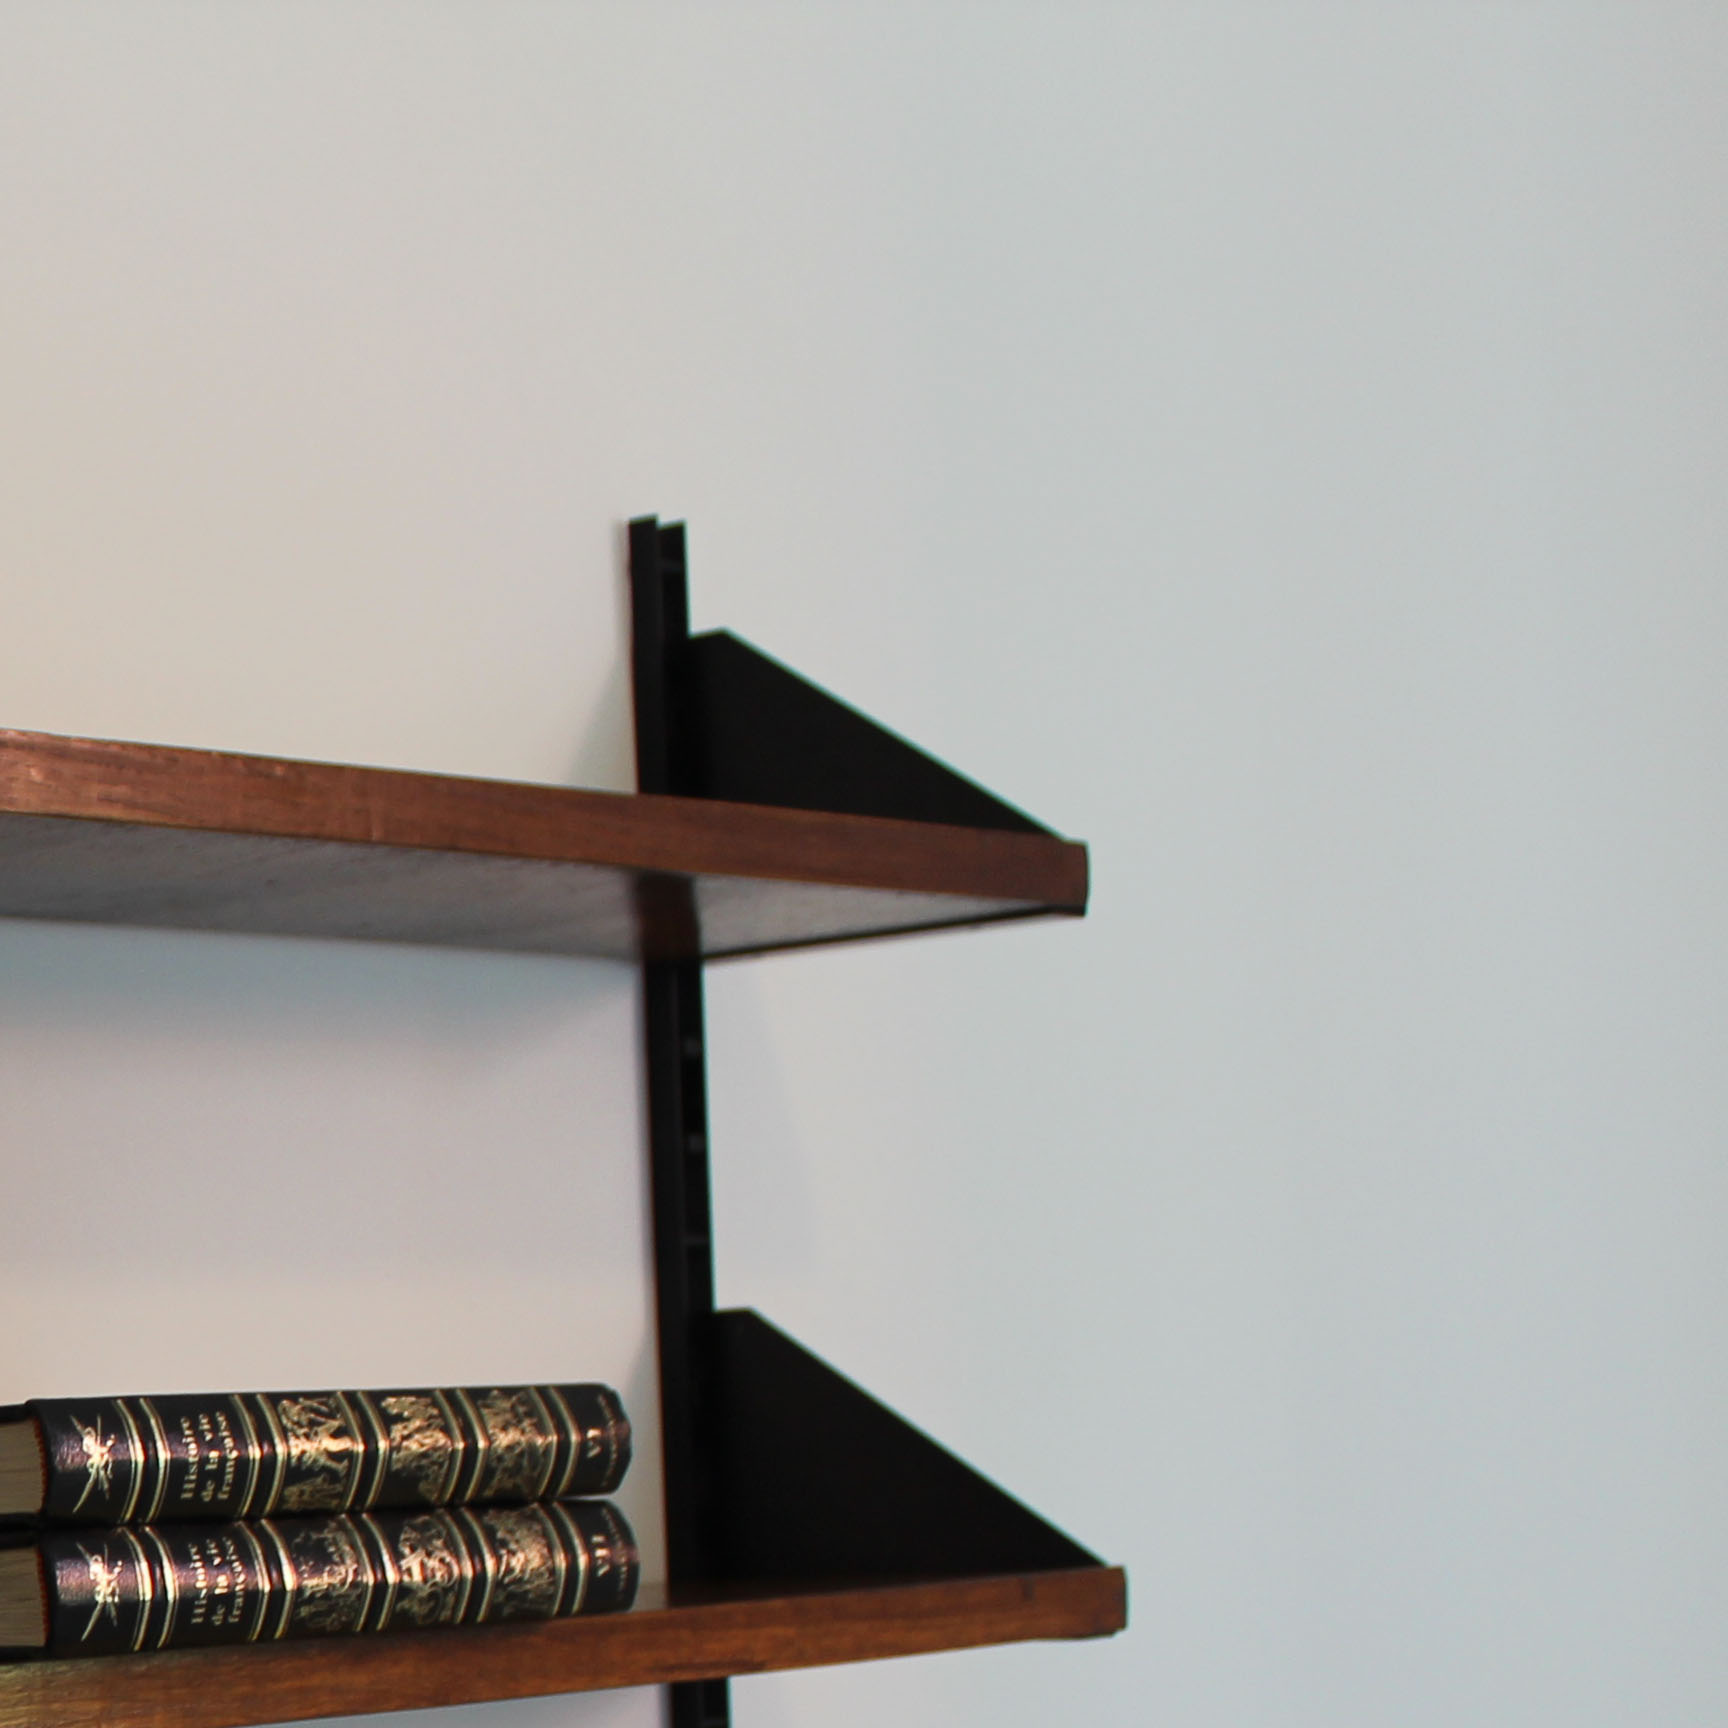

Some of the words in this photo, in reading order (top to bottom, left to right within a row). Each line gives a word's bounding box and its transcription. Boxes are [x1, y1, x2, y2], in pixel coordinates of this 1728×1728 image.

[198, 1413, 213, 1442] vie
[180, 1416, 199, 1500] Histoire
[215, 1410, 238, 1501] française
[586, 1429, 602, 1458] VI
[205, 1449, 221, 1470] la
[200, 1479, 216, 1503] de
[206, 1538, 222, 1567] vie
[591, 1535, 610, 1578] VII
[188, 1543, 207, 1624] Histoire
[214, 1574, 230, 1595] la
[222, 1536, 247, 1623] française
[212, 1603, 226, 1626] de
